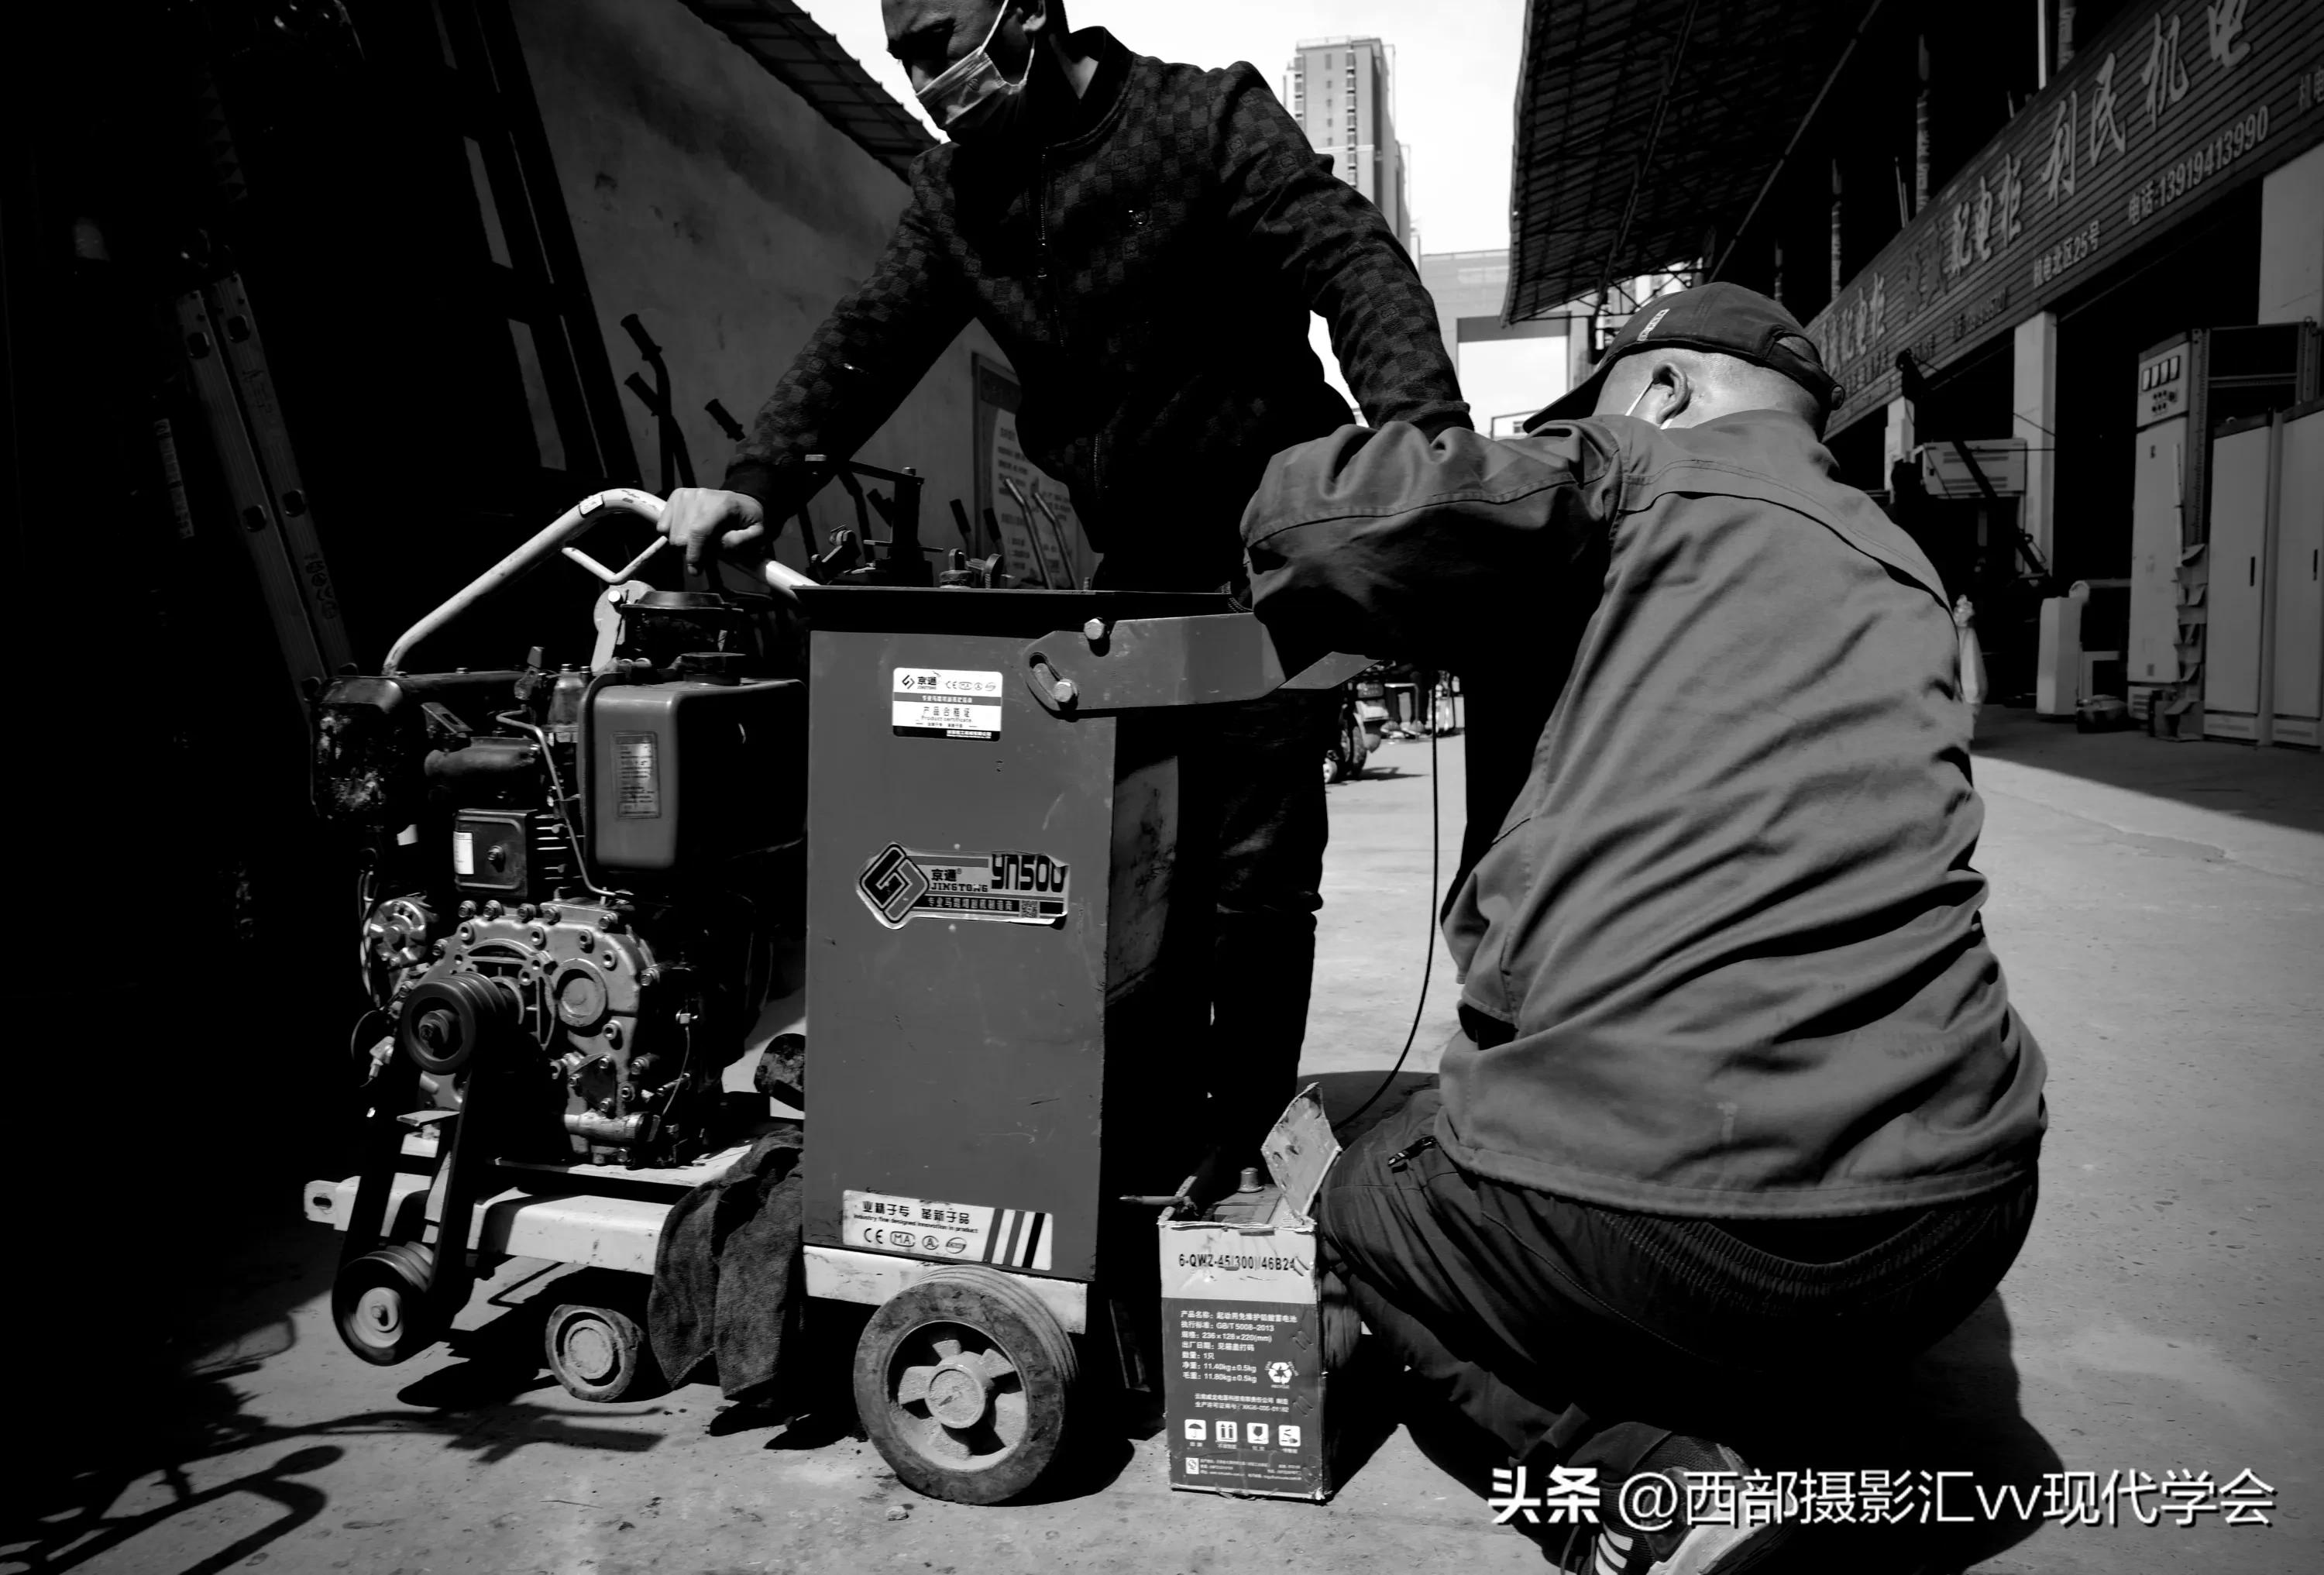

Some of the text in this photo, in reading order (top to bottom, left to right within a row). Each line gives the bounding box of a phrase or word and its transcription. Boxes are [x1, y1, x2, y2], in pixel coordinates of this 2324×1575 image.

[2041, 0, 2252, 207] 利民机电
[2127, 105, 2270, 226] 电话:13919413990
[931, 868, 957, 882] 京通
[864, 1227, 883, 1243] CE
